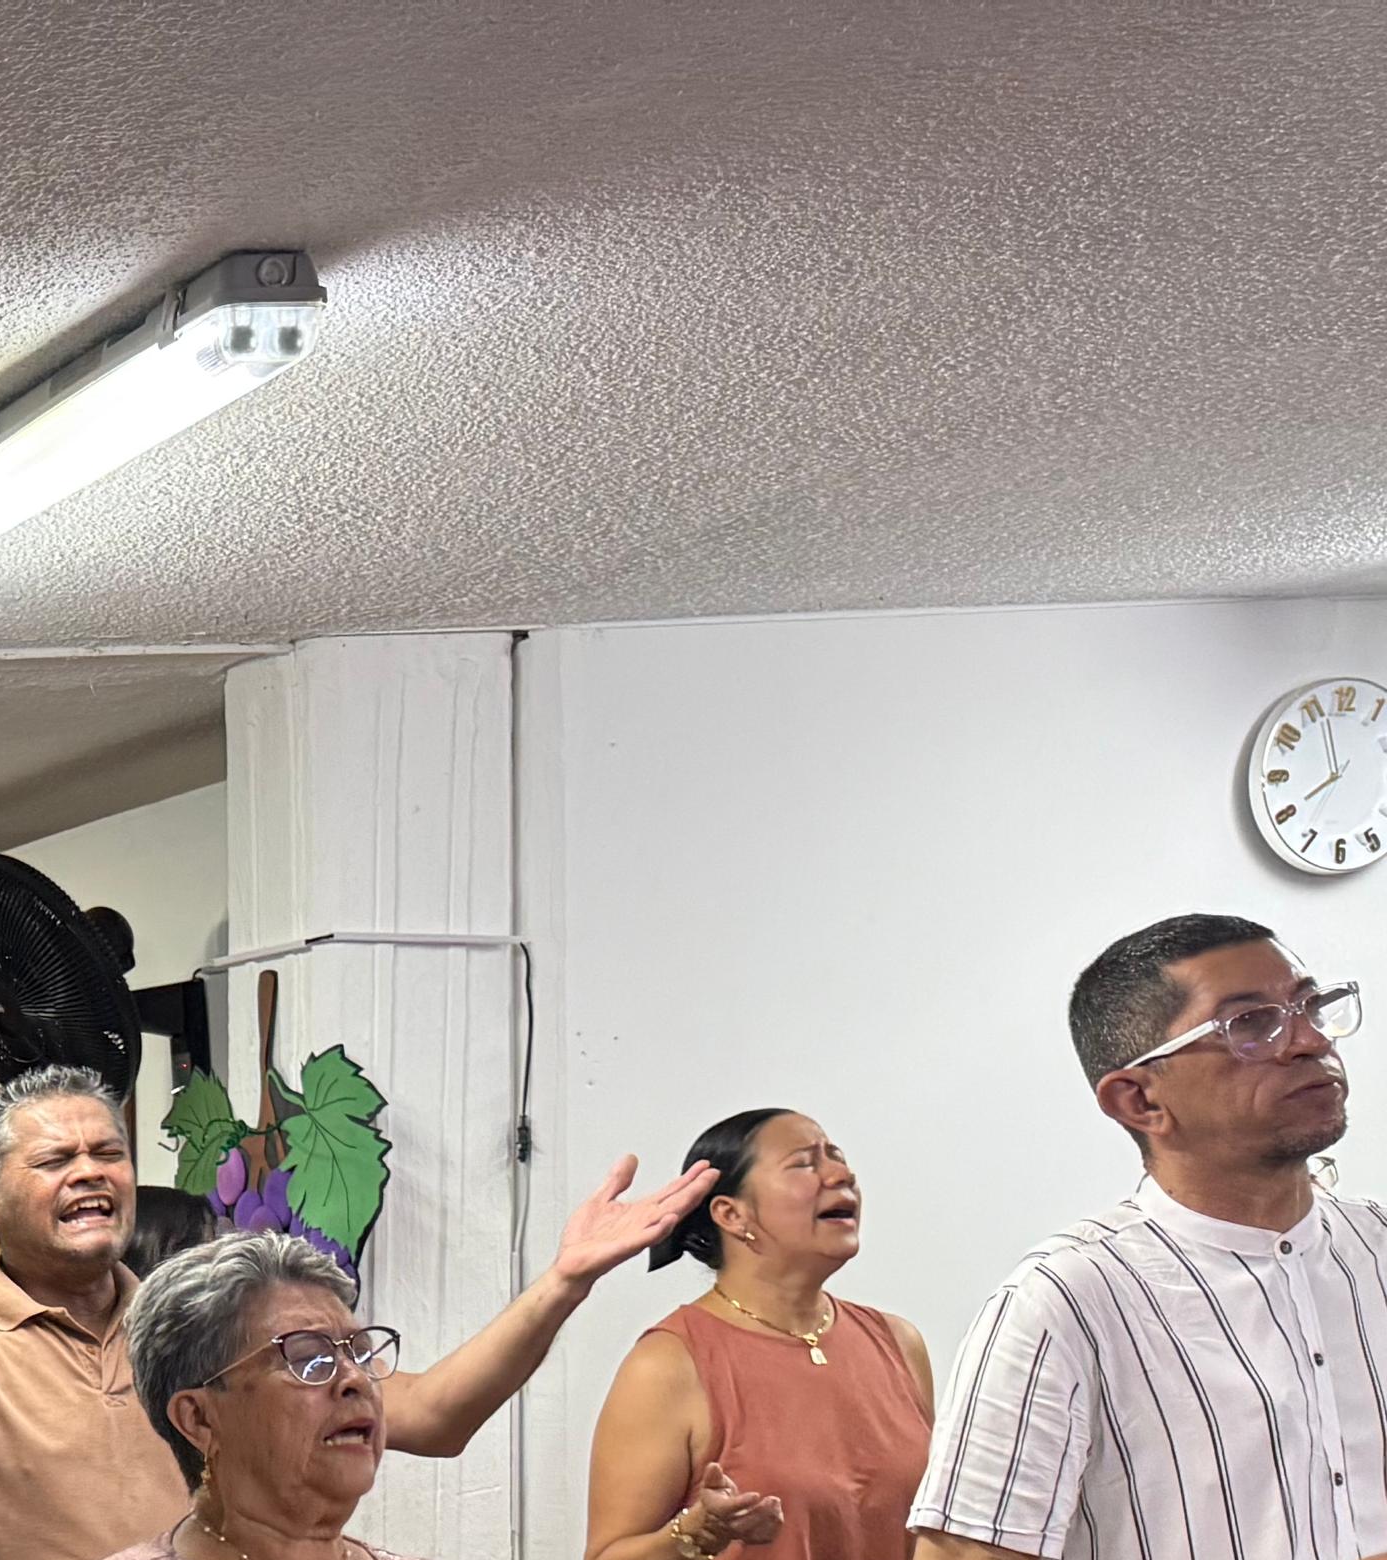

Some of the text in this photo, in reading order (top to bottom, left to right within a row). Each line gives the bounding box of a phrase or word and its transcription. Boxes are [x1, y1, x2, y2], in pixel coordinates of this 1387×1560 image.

[1301, 694, 1325, 723] 11
[1335, 686, 1356, 712] 12
[1371, 698, 1386, 722] 1
[1276, 723, 1301, 751] 10
[1267, 769, 1289, 784] 9
[1276, 804, 1297, 825] 8
[1301, 829, 1318, 853] 7
[1335, 838, 1346, 864] 6
[1364, 828, 1381, 852] 5
